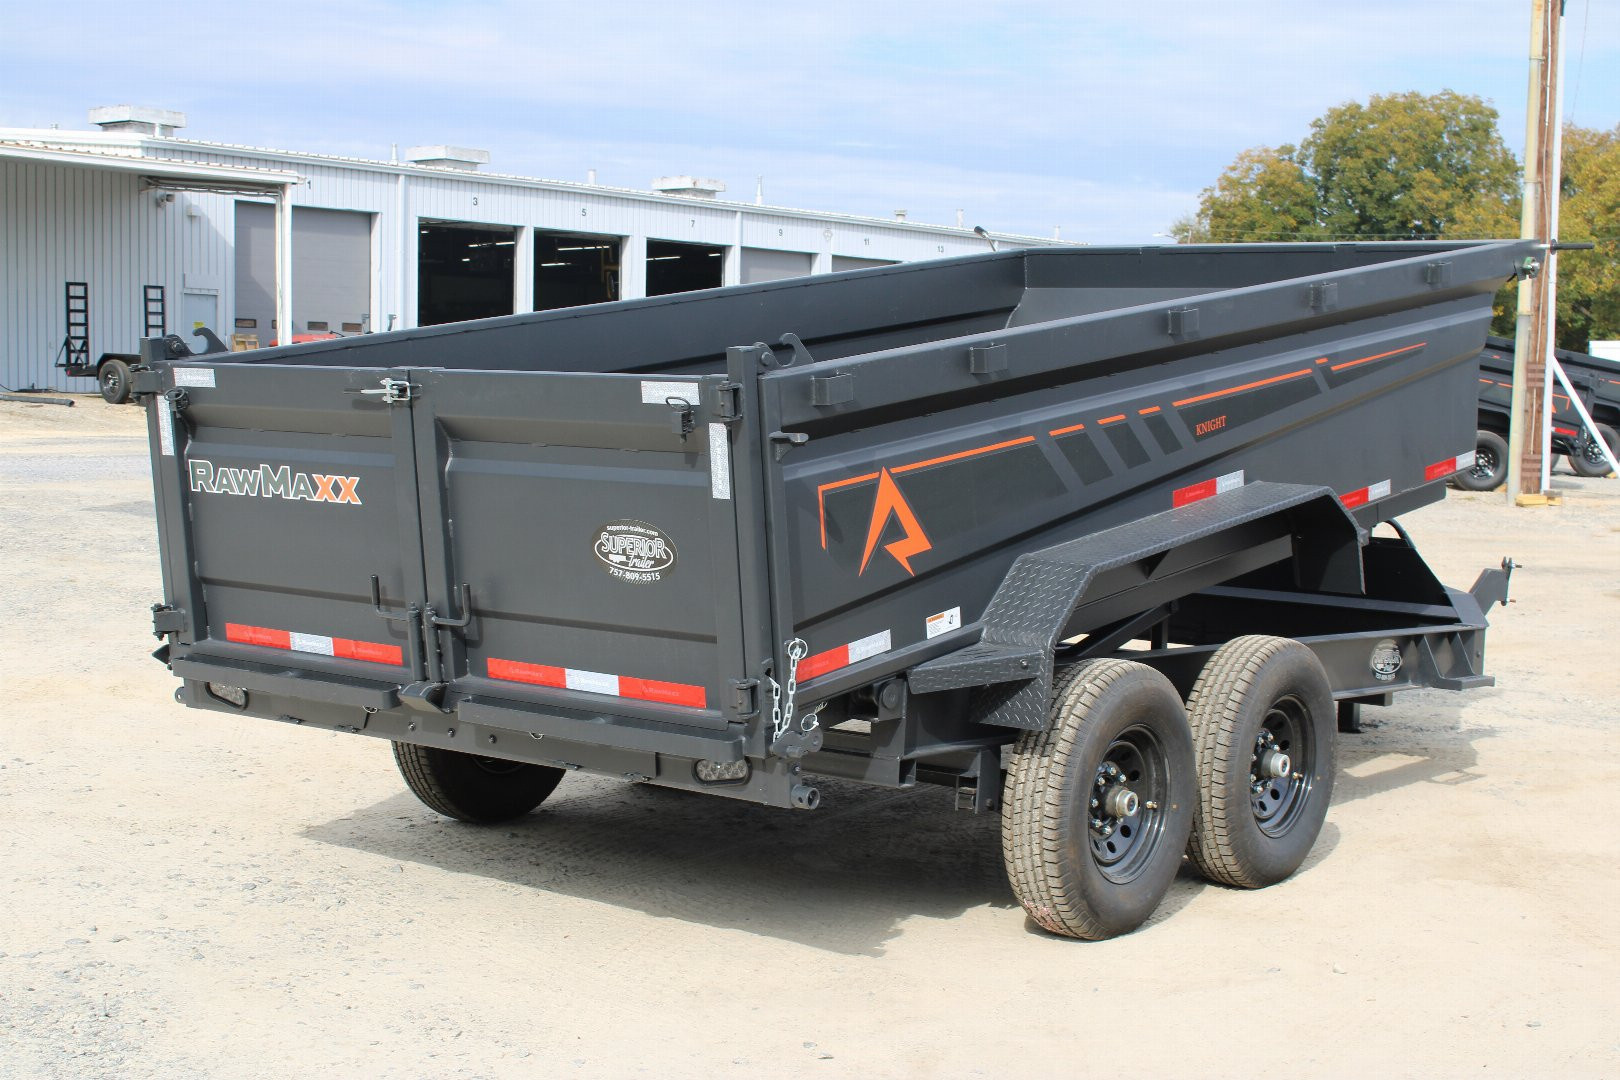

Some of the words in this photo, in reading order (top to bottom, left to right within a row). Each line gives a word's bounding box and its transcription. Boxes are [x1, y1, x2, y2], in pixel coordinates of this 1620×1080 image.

[472, 197, 478, 206] 3
[581, 208, 587, 217] 5
[690, 219, 696, 228] 7
[1195, 415, 1227, 436] KNIGHT
[606, 525, 659, 537] superior-trailer.com
[600, 531, 668, 560] SUPERIOR
[609, 566, 661, 581] 757-809-5515
